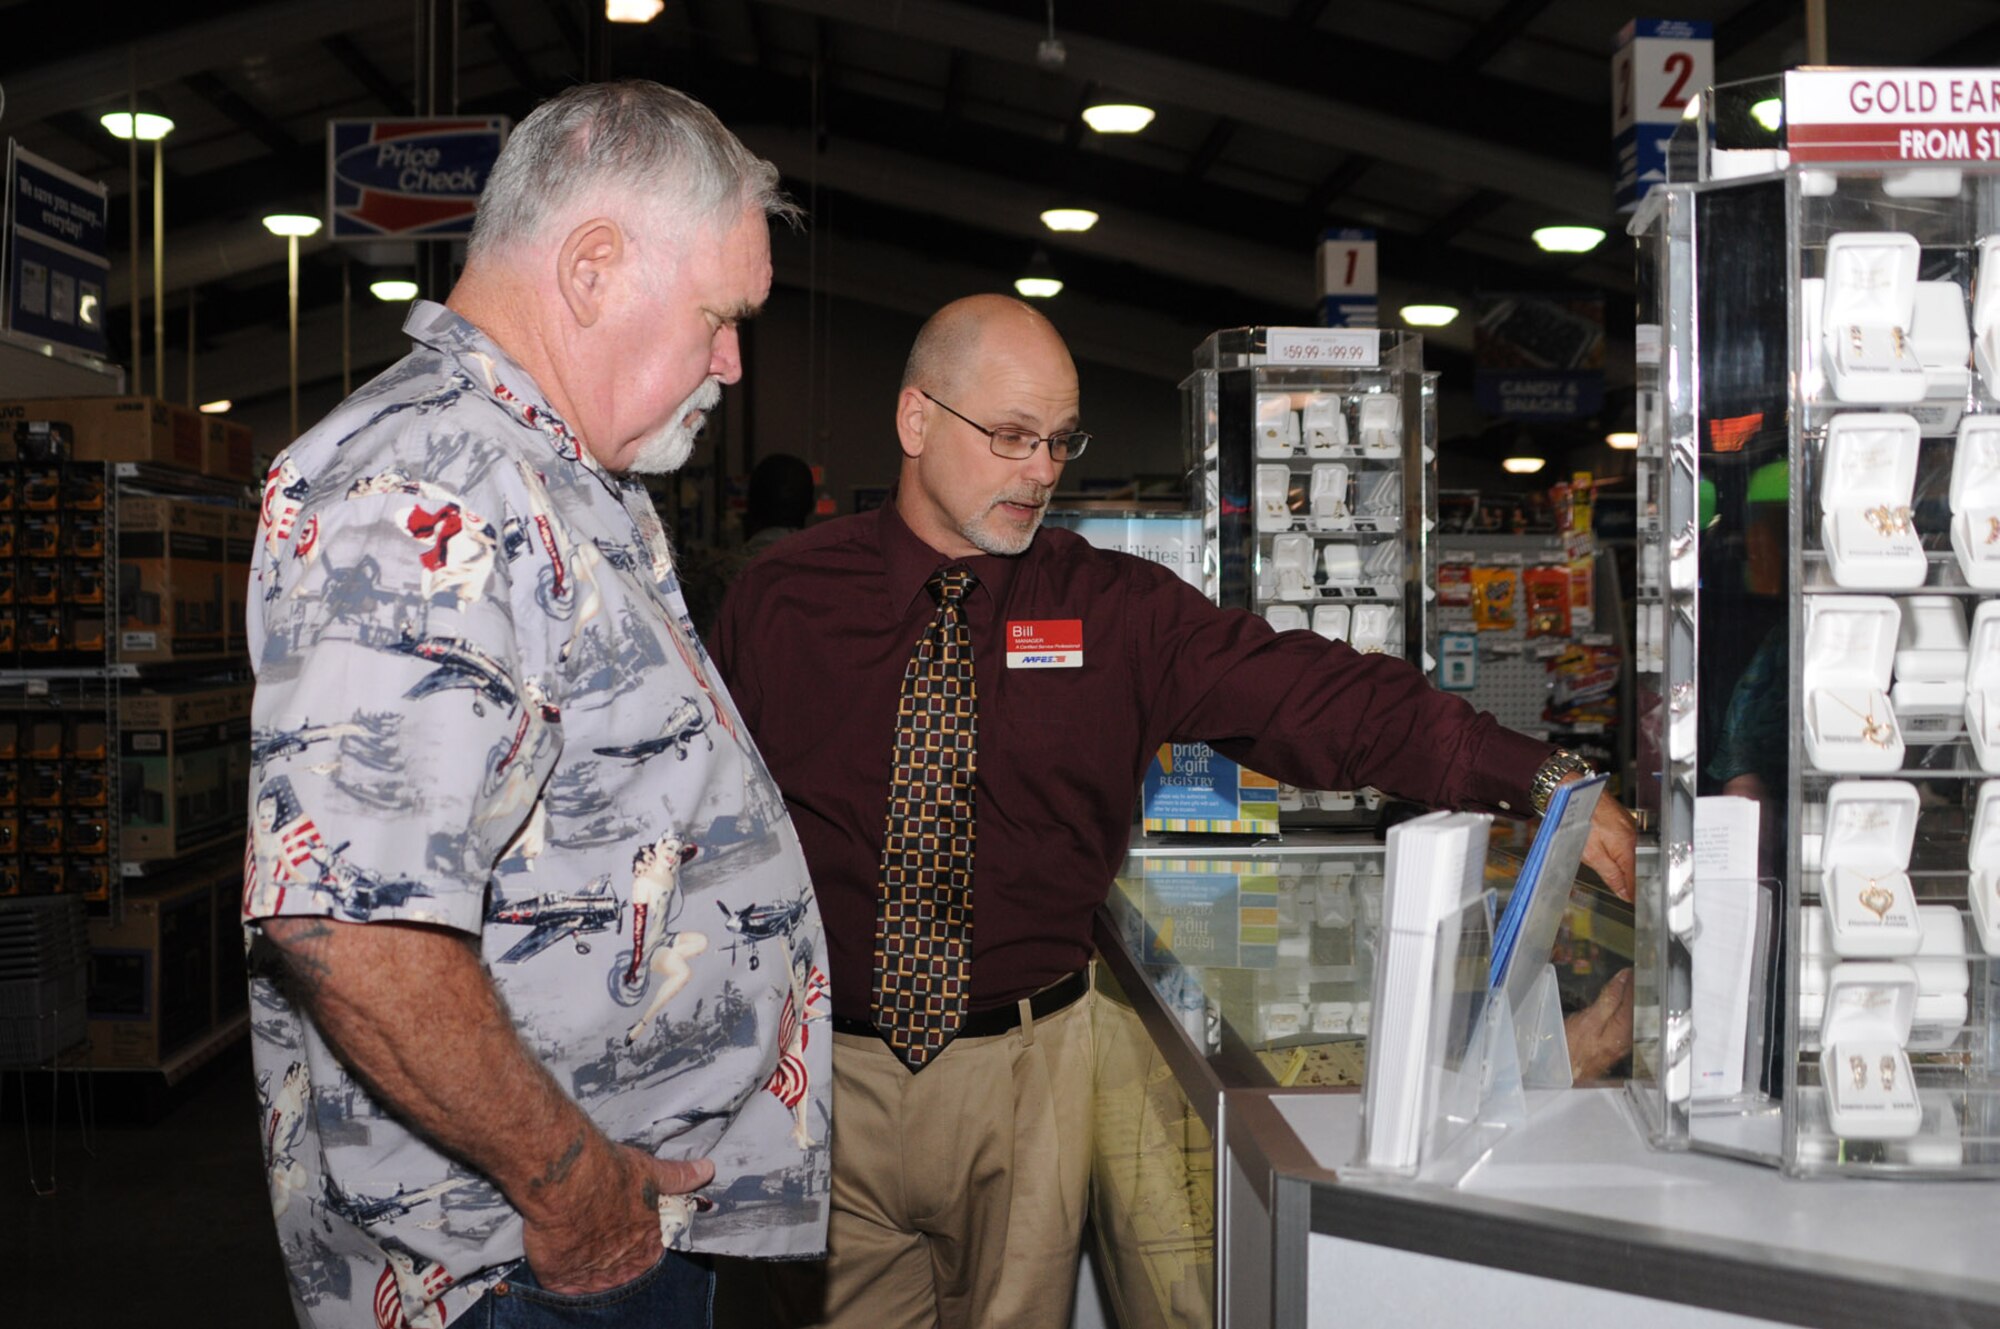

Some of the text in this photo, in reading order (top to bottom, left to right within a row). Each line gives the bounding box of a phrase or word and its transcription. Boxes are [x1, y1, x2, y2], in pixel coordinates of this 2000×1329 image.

[1659, 52, 1695, 109] 2
[1849, 80, 1937, 113] GOLD
[375, 143, 442, 168] Price
[1900, 129, 1971, 160] FROM
[398, 165, 479, 192] Check
[1345, 250, 1357, 286] 1
[1283, 345, 1319, 359] $59.99
[1328, 345, 1364, 360] $99.99
[1012, 625, 1034, 638] Bill
[1160, 776, 1215, 787] REGISTRY
